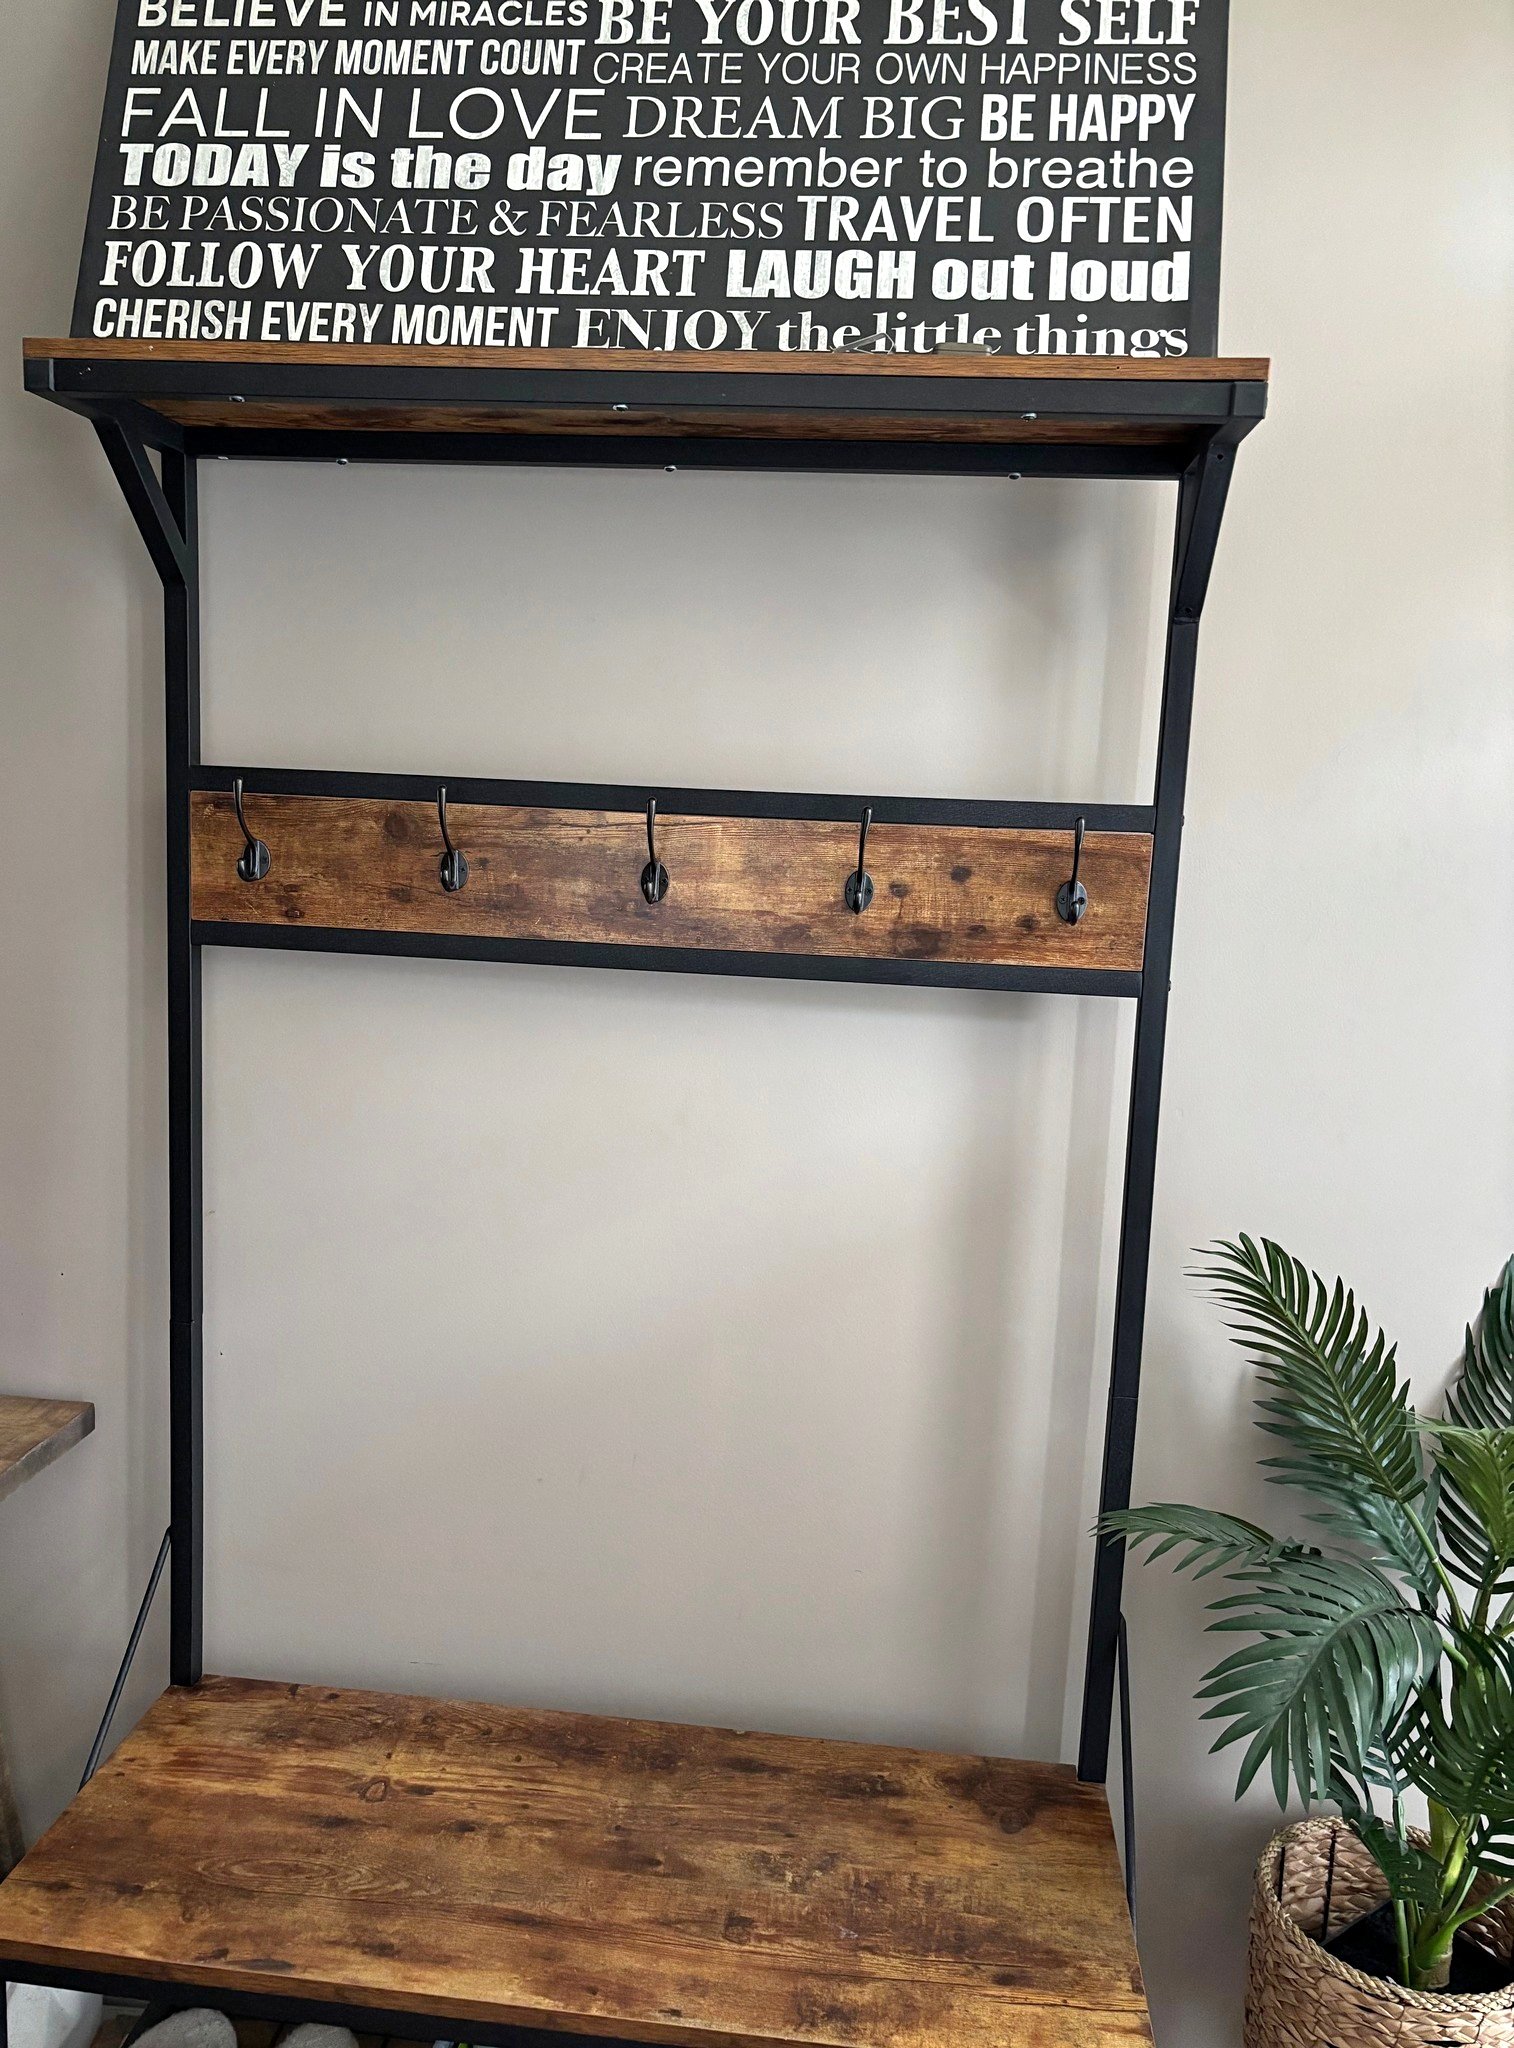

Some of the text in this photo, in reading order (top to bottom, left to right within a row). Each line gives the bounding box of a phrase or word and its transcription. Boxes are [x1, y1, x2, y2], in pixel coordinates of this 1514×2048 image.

[137, 0, 588, 27] BELIEVE IN MIRACLES
[593, 0, 1199, 46] BE YOUR BEST SELF
[131, 39, 585, 76] MAKE EVERY MOMENT COUNT
[594, 52, 1196, 86] CREATE YOUR OWN HAPPINESS
[121, 87, 605, 140] FALL IN LOVE
[623, 95, 965, 140] DREAM BIG
[981, 93, 1196, 142] BE HAPPY
[120, 143, 622, 196] TODAY is the day
[635, 147, 1193, 190] remember to breathe
[108, 196, 783, 240] BE PASSIONATE & FEARLESS
[797, 195, 1192, 244] TRAVEL OFTEN
[99, 240, 705, 297] FOLLOW YOUR HEART
[726, 250, 1190, 303] LAUGH out loud
[93, 298, 559, 347] CHERISH EVERY MOMENT
[572, 308, 1188, 358] ENJOY the little things
